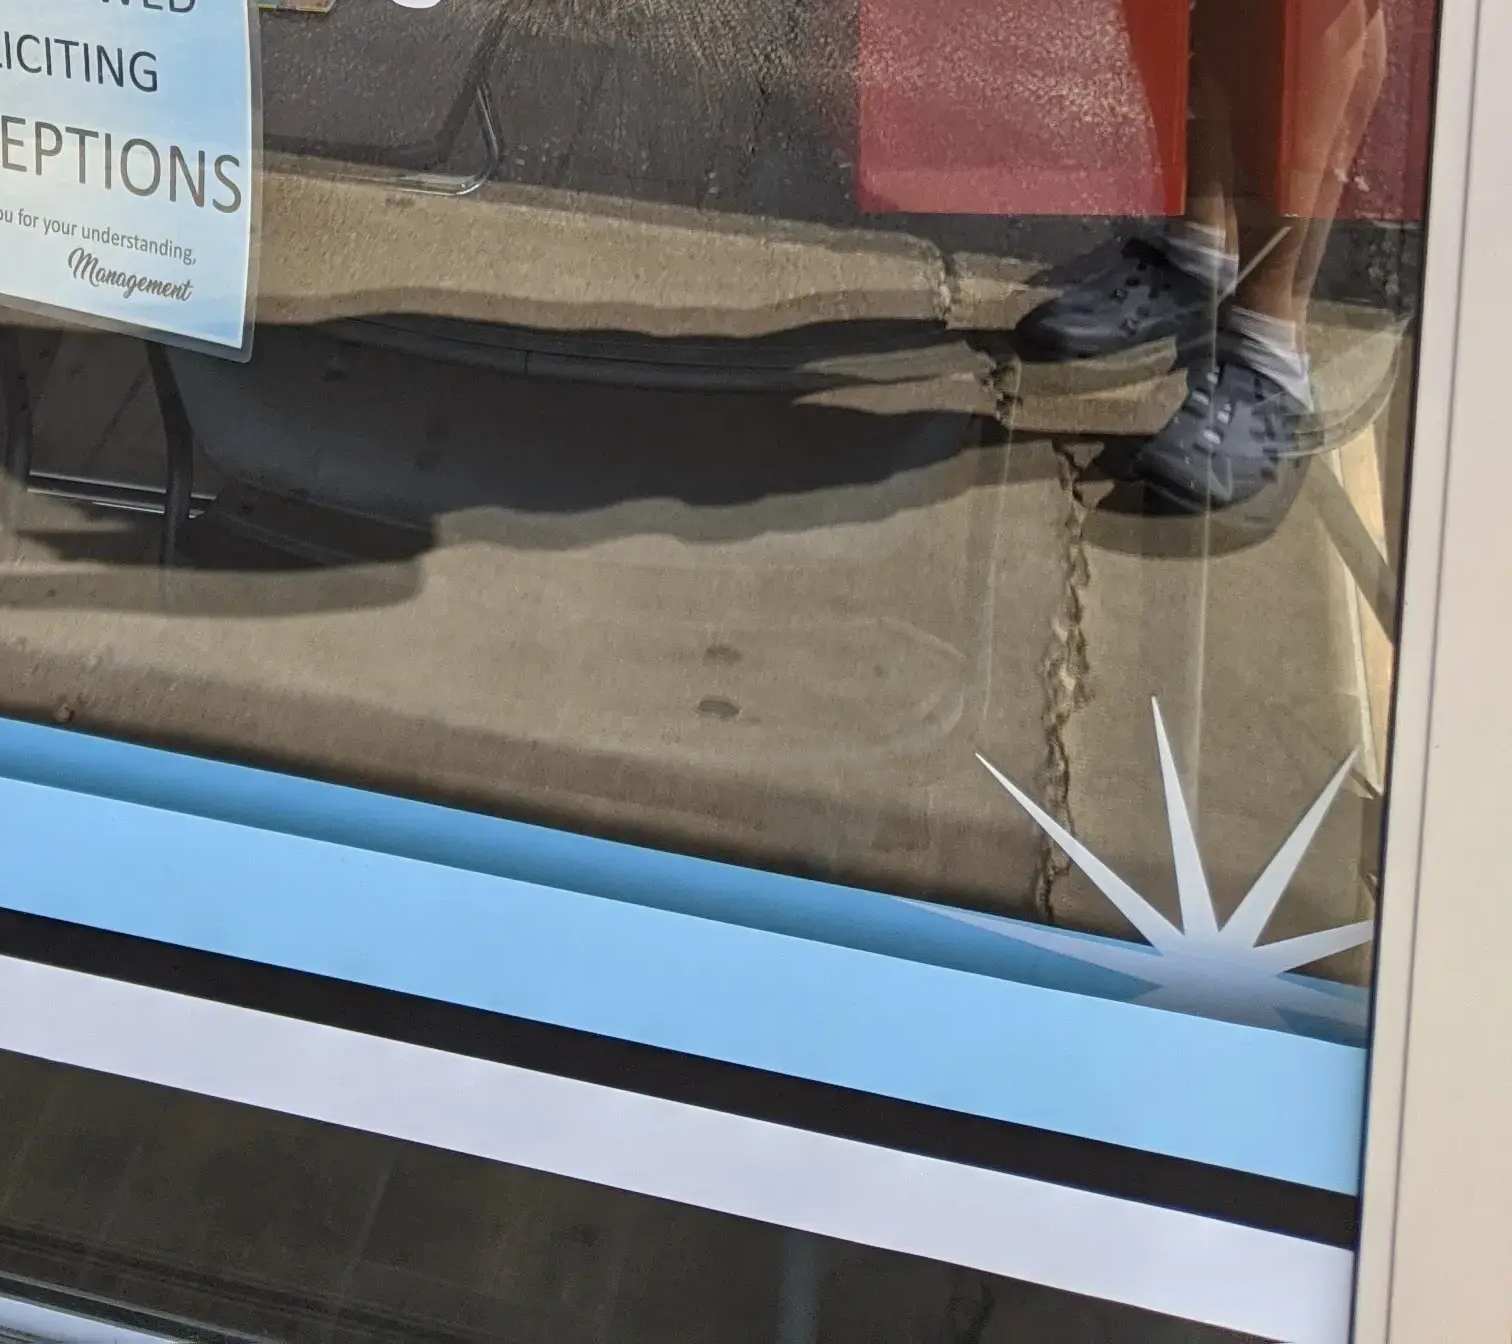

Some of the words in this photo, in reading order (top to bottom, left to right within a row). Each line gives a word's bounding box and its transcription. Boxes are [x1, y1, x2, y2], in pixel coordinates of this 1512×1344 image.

[17, 209, 40, 229] for
[43, 216, 78, 237] your
[81, 222, 197, 266] understanding,
[67, 247, 194, 302] Management
